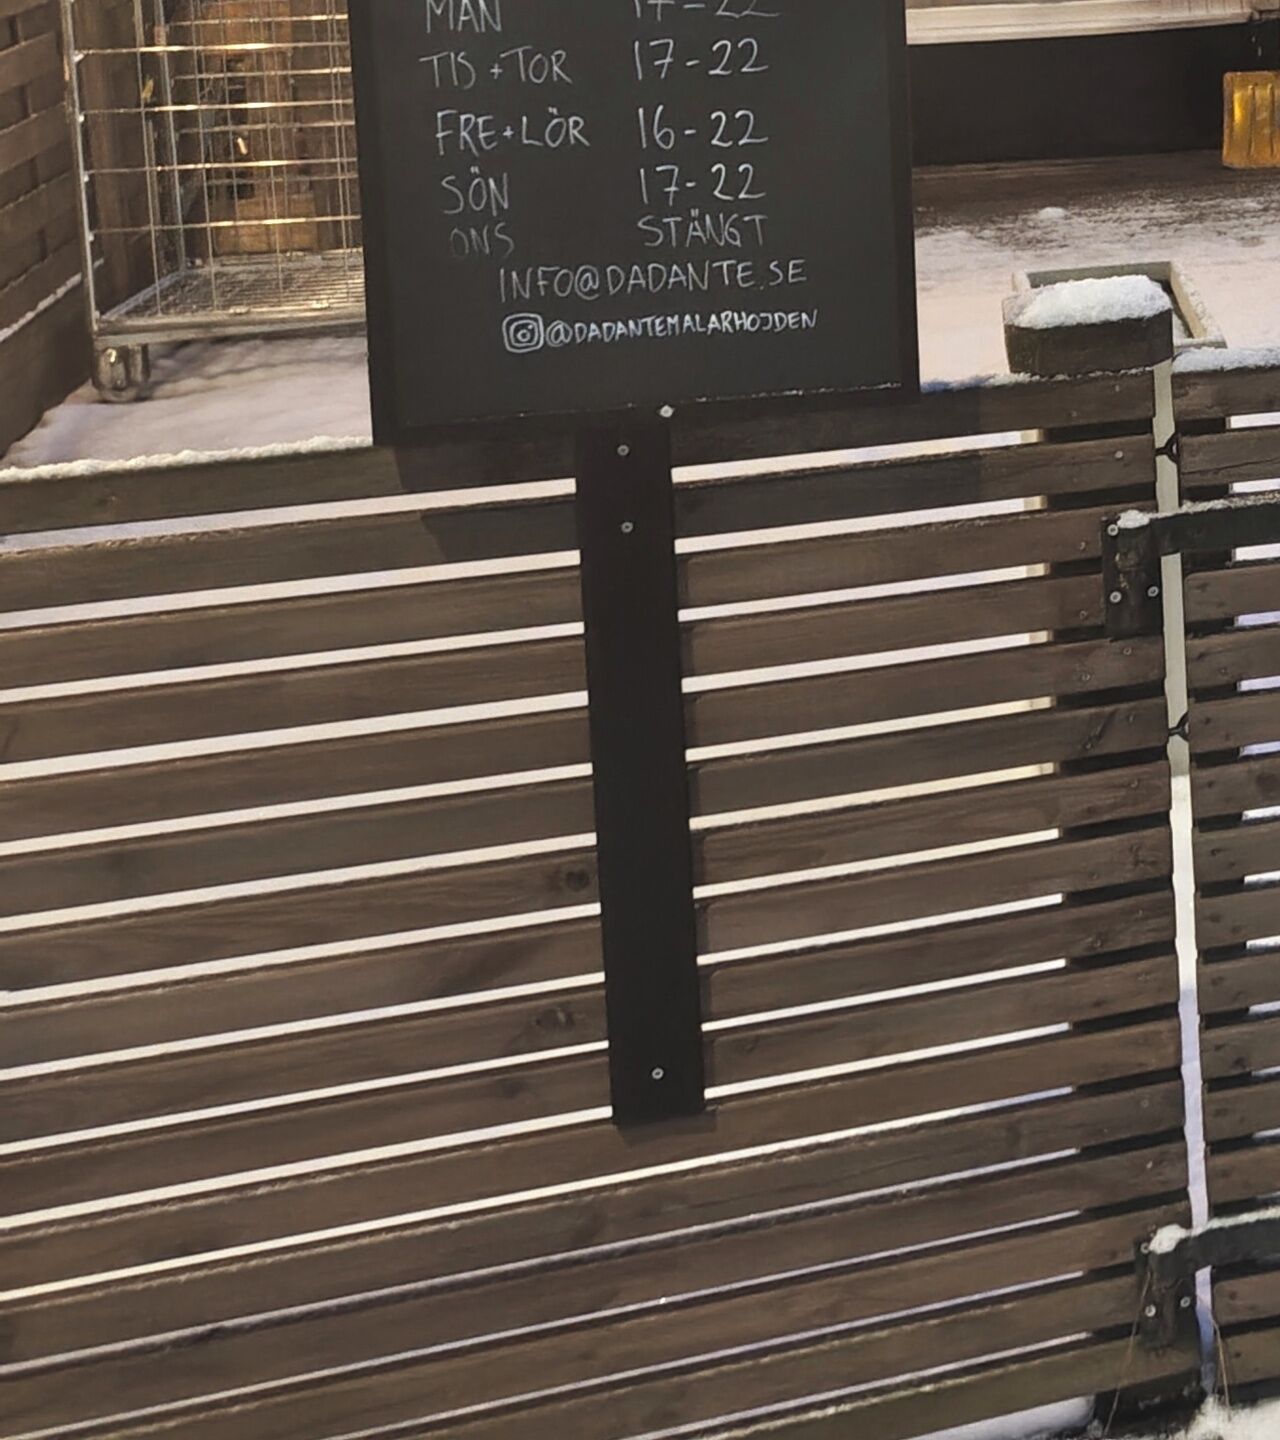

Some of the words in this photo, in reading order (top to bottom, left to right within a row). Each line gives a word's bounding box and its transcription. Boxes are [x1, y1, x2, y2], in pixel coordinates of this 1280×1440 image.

[441, 166, 508, 217] SÖN
[450, 222, 515, 259] ONS
[637, 208, 768, 248] STÄNGT
[500, 259, 808, 302] INFO@DADANTE.SE
[545, 309, 818, 348] @DADANTEMALARHOJDEN
